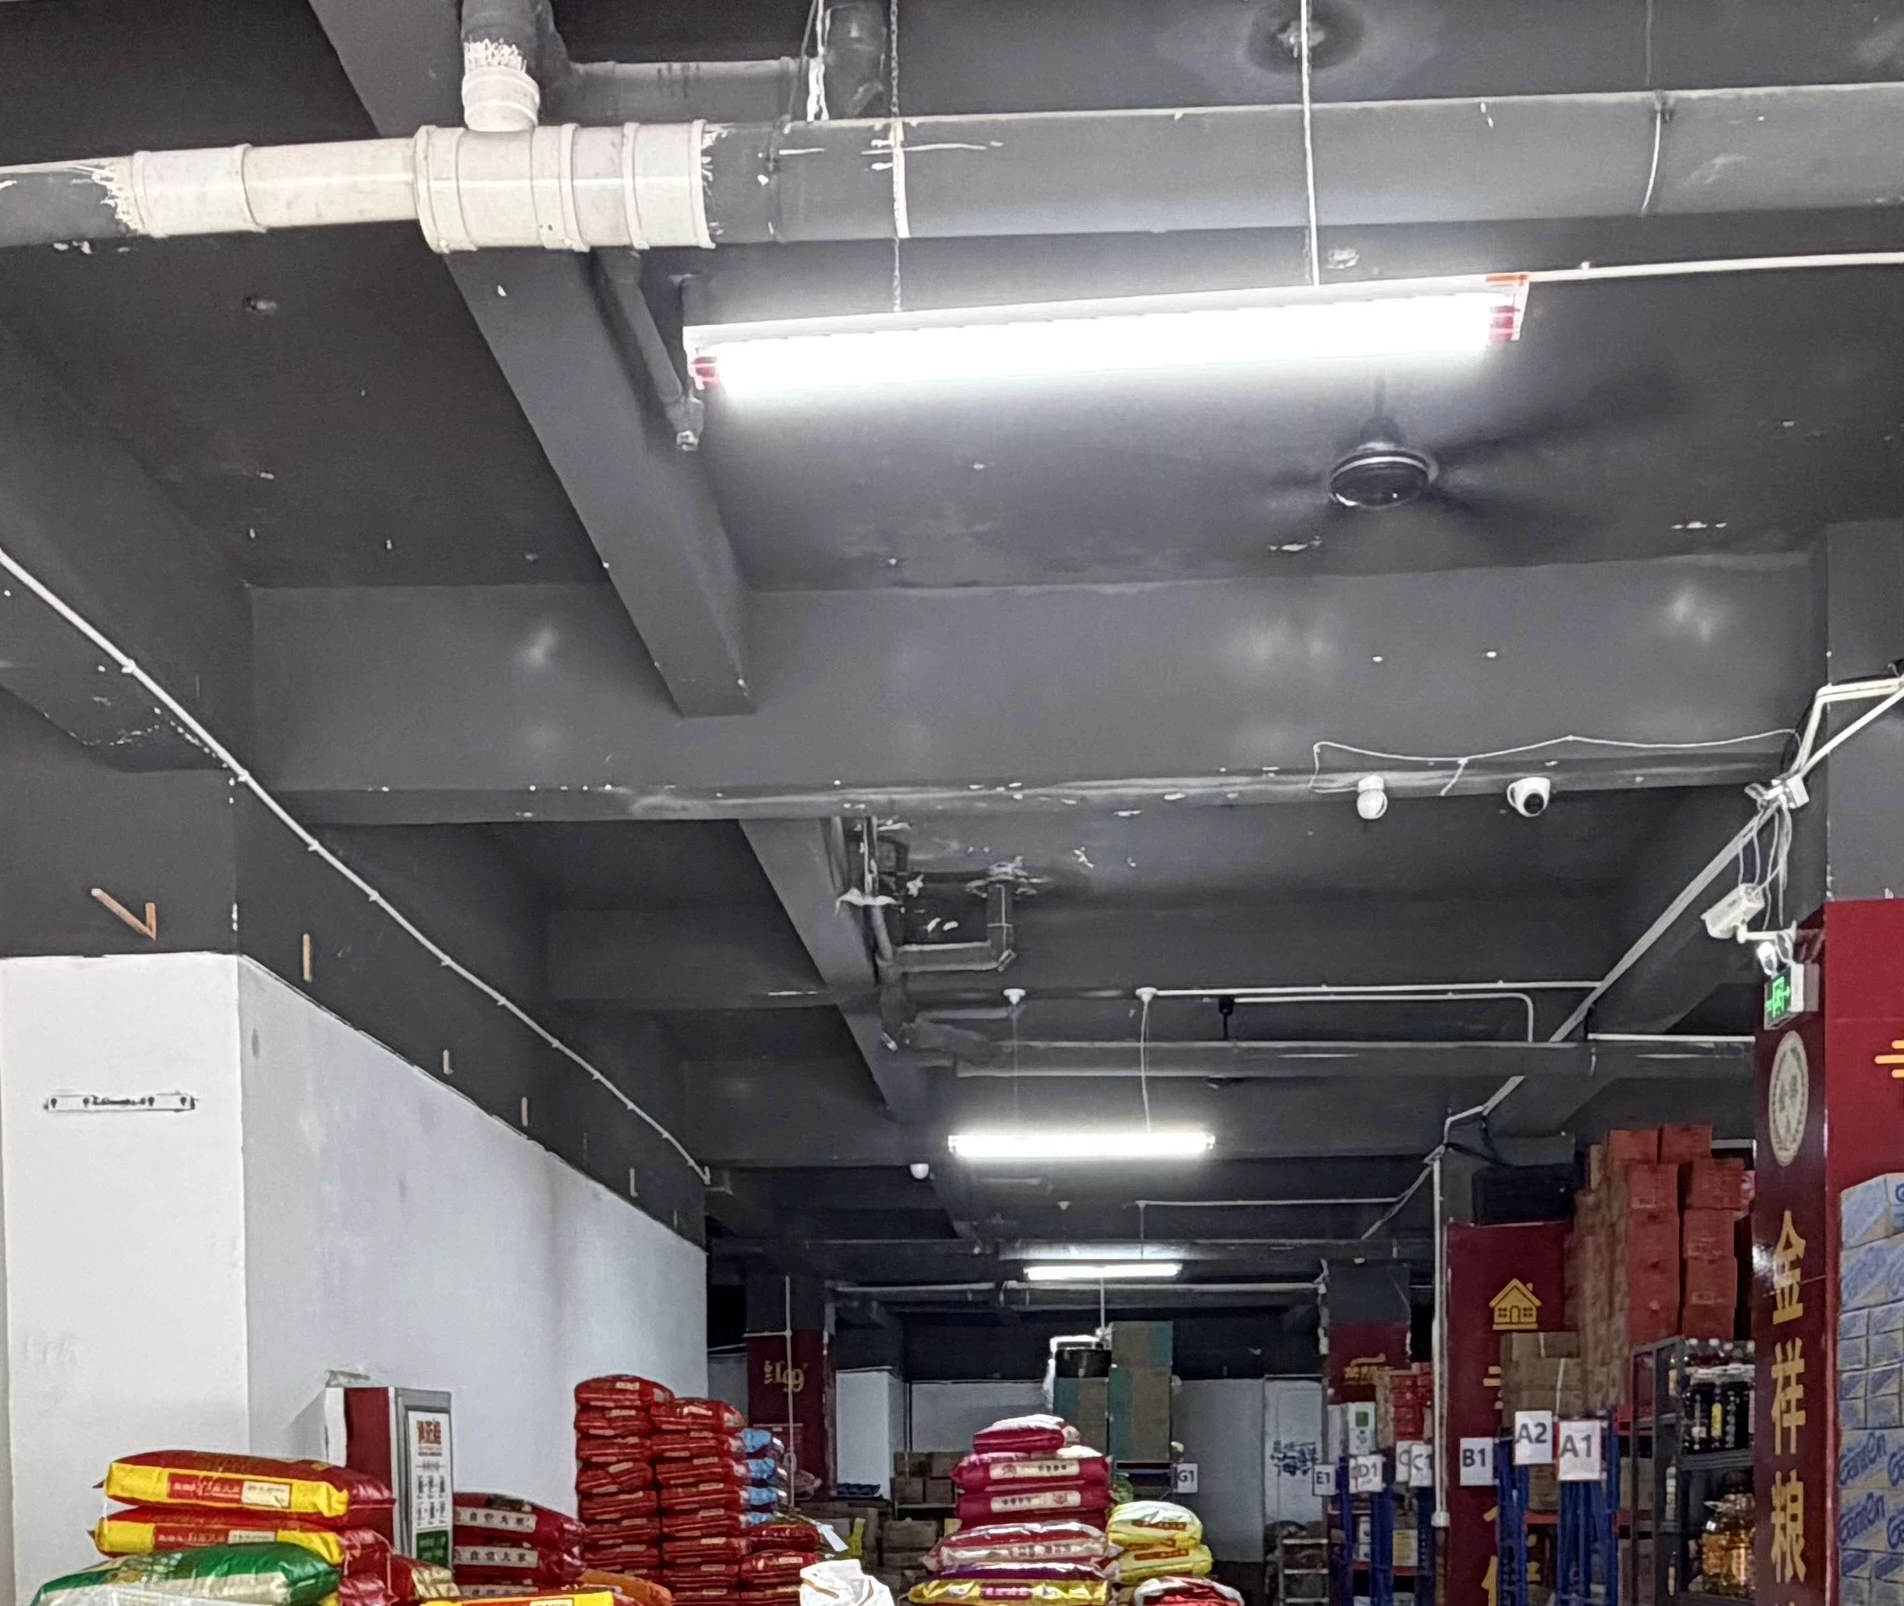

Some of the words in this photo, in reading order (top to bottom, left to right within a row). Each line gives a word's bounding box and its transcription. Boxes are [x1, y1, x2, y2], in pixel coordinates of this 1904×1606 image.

[1516, 1423, 1548, 1444] A2
[1561, 1434, 1592, 1458] A1
[1463, 1449, 1486, 1467] B1
[1177, 1469, 1195, 1482] G1
[1316, 1472, 1331, 1484] E1
